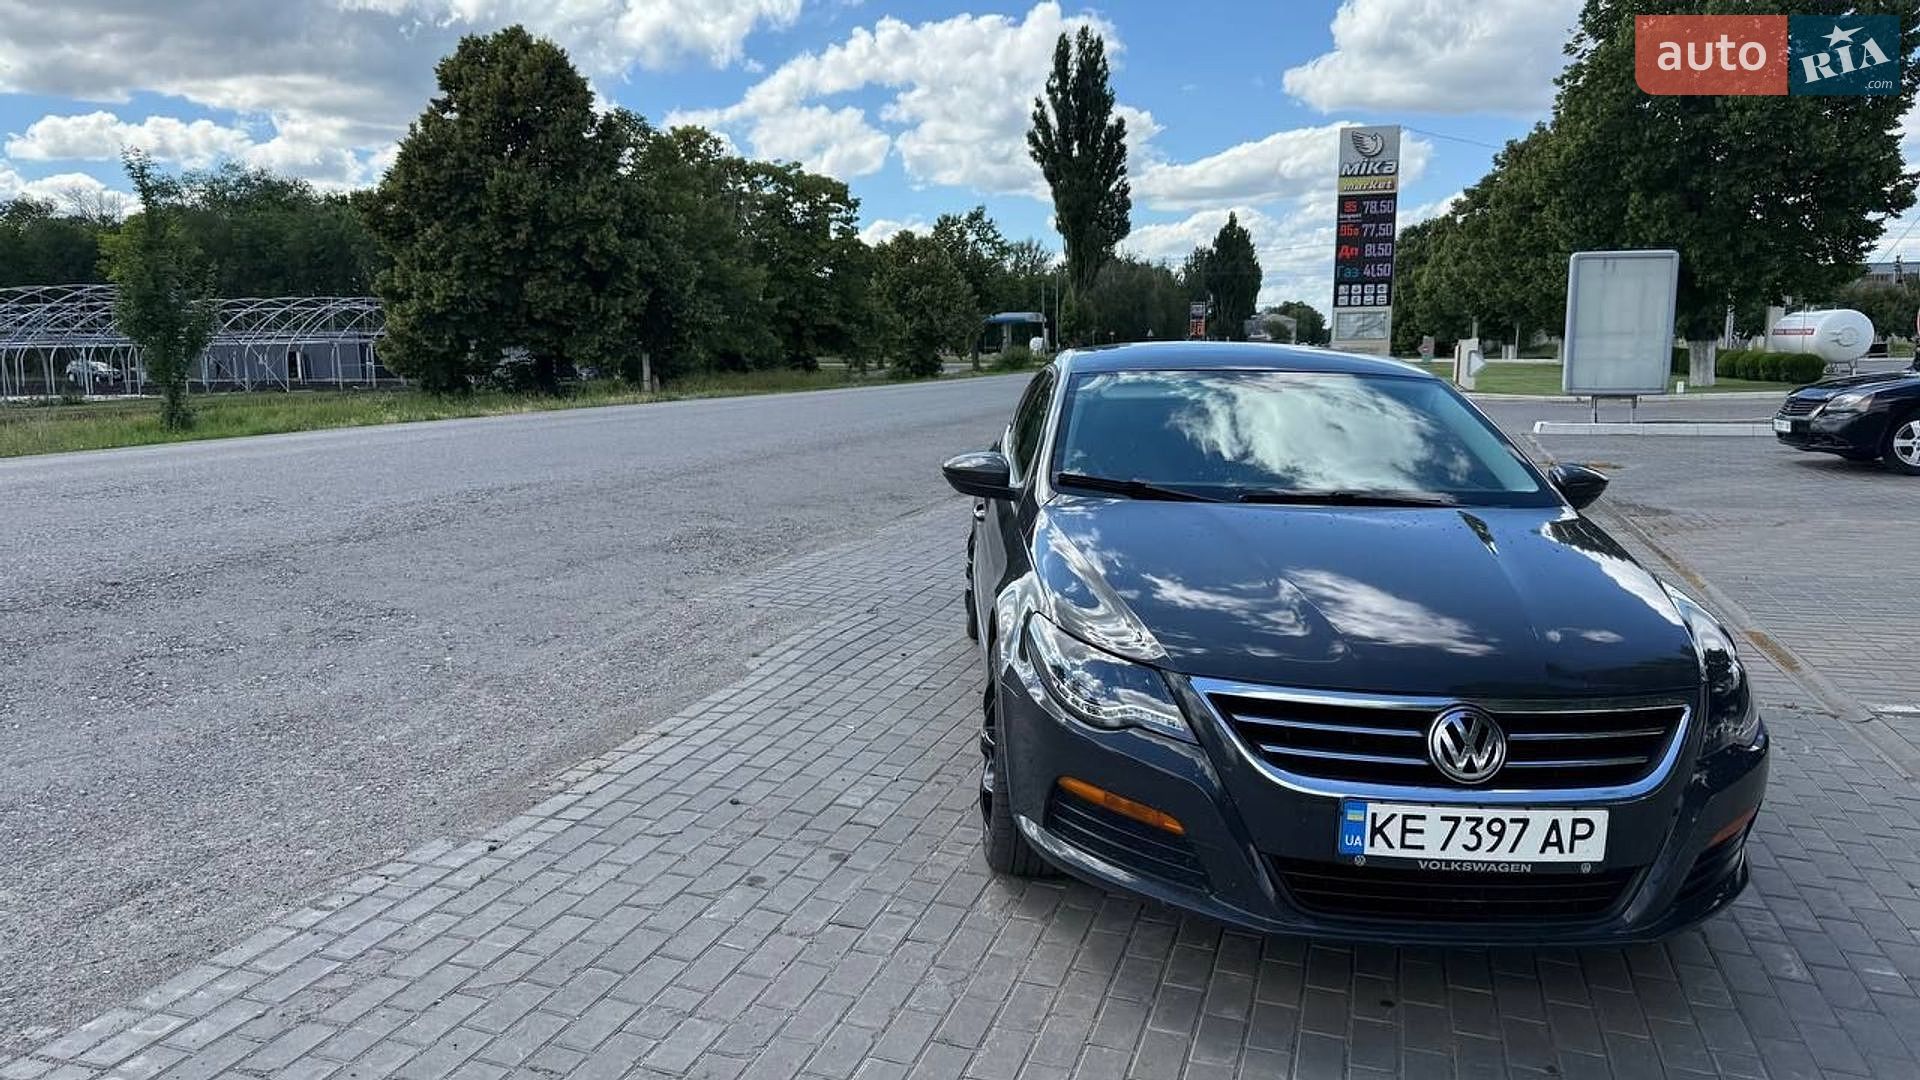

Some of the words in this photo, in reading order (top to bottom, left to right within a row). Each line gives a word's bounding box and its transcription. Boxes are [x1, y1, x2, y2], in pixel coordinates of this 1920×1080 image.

[1368, 812, 1427, 850] KE
[1439, 816, 1530, 853] 7397
[1539, 818, 1596, 855] AP
[1344, 834, 1363, 848] UA
[1417, 860, 1533, 873] VOLKSWAGEN
